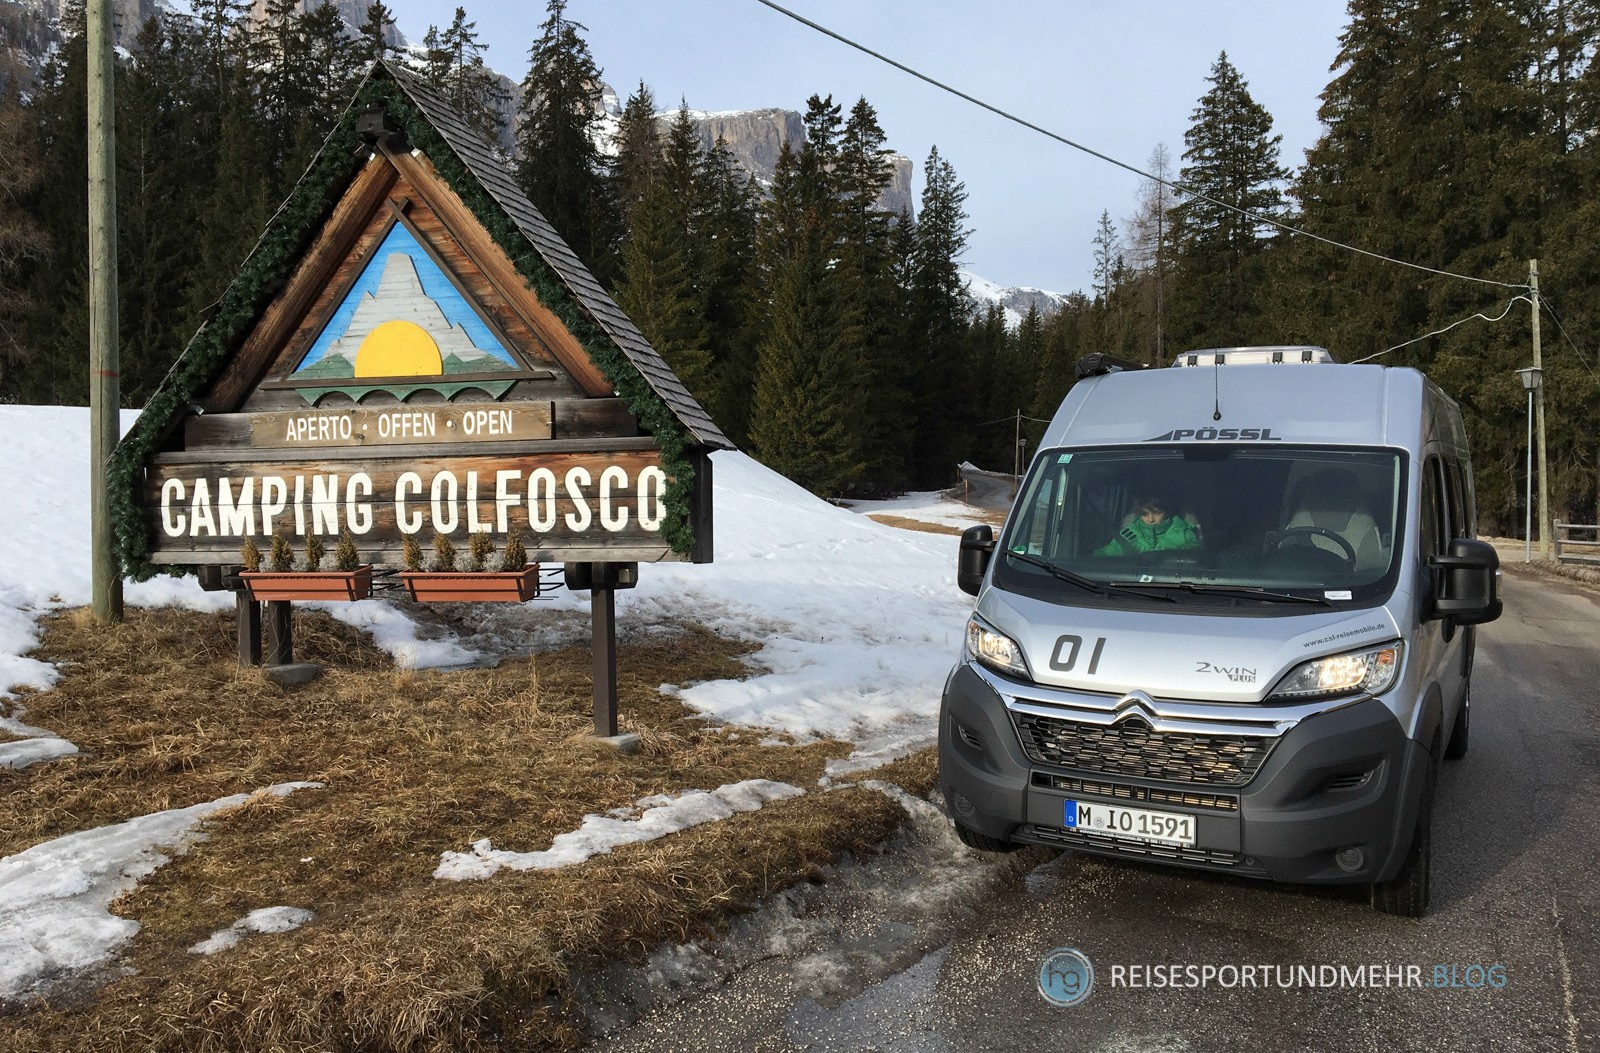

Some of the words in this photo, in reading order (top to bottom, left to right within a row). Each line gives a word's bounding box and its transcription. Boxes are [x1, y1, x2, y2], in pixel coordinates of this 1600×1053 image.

[285, 415, 351, 441] APERTO
[377, 412, 436, 438] OFFEN
[462, 410, 513, 435] OPEN
[1172, 426, 1282, 441] PÖSSL
[161, 472, 373, 537] CAMPING
[395, 465, 667, 534] COLFOSCO
[1303, 623, 1386, 647] www.csl-reisemobile.de
[1231, 674, 1256, 683] PLUS
[1078, 805, 1091, 826] M
[1107, 810, 1133, 832] IO
[1138, 814, 1192, 840] 1591
